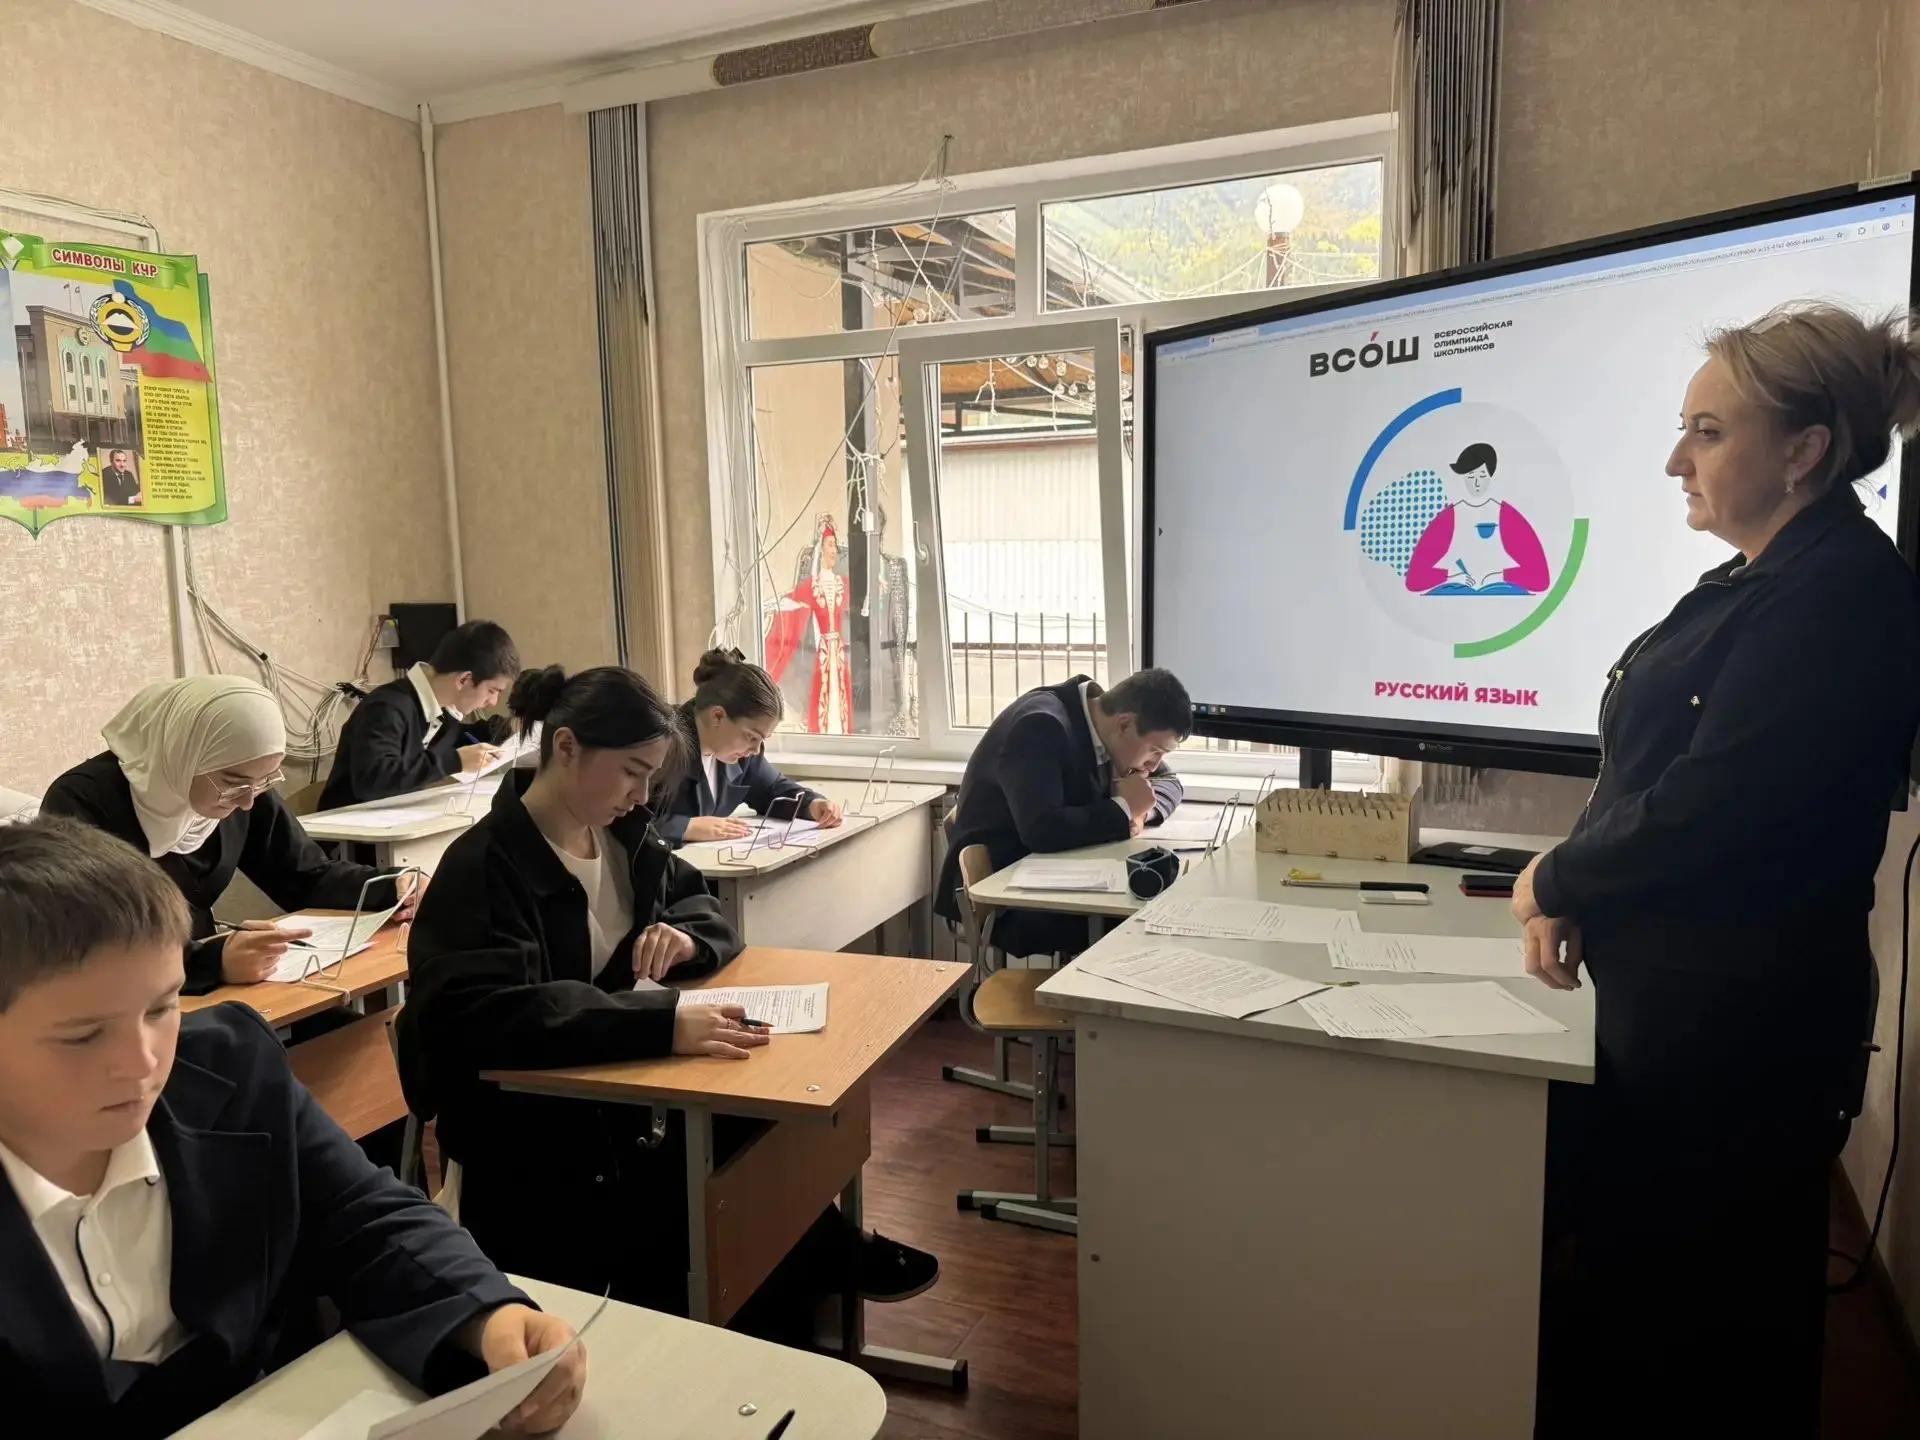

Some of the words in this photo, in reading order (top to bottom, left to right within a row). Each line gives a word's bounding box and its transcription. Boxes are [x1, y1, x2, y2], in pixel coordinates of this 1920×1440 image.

[52, 248, 125, 272] СИМВОЛЫ
[132, 261, 158, 277] КЧР
[1434, 320, 1513, 339] ВСЕРОССИЙСКАЯ
[1433, 342, 1495, 358] ШКОЛЬНИКОВ
[1434, 334, 1489, 349] ОЛИМПИАДА
[1374, 681, 1469, 702] РУССКИЙ
[1475, 687, 1538, 706] ЯЗЫК
